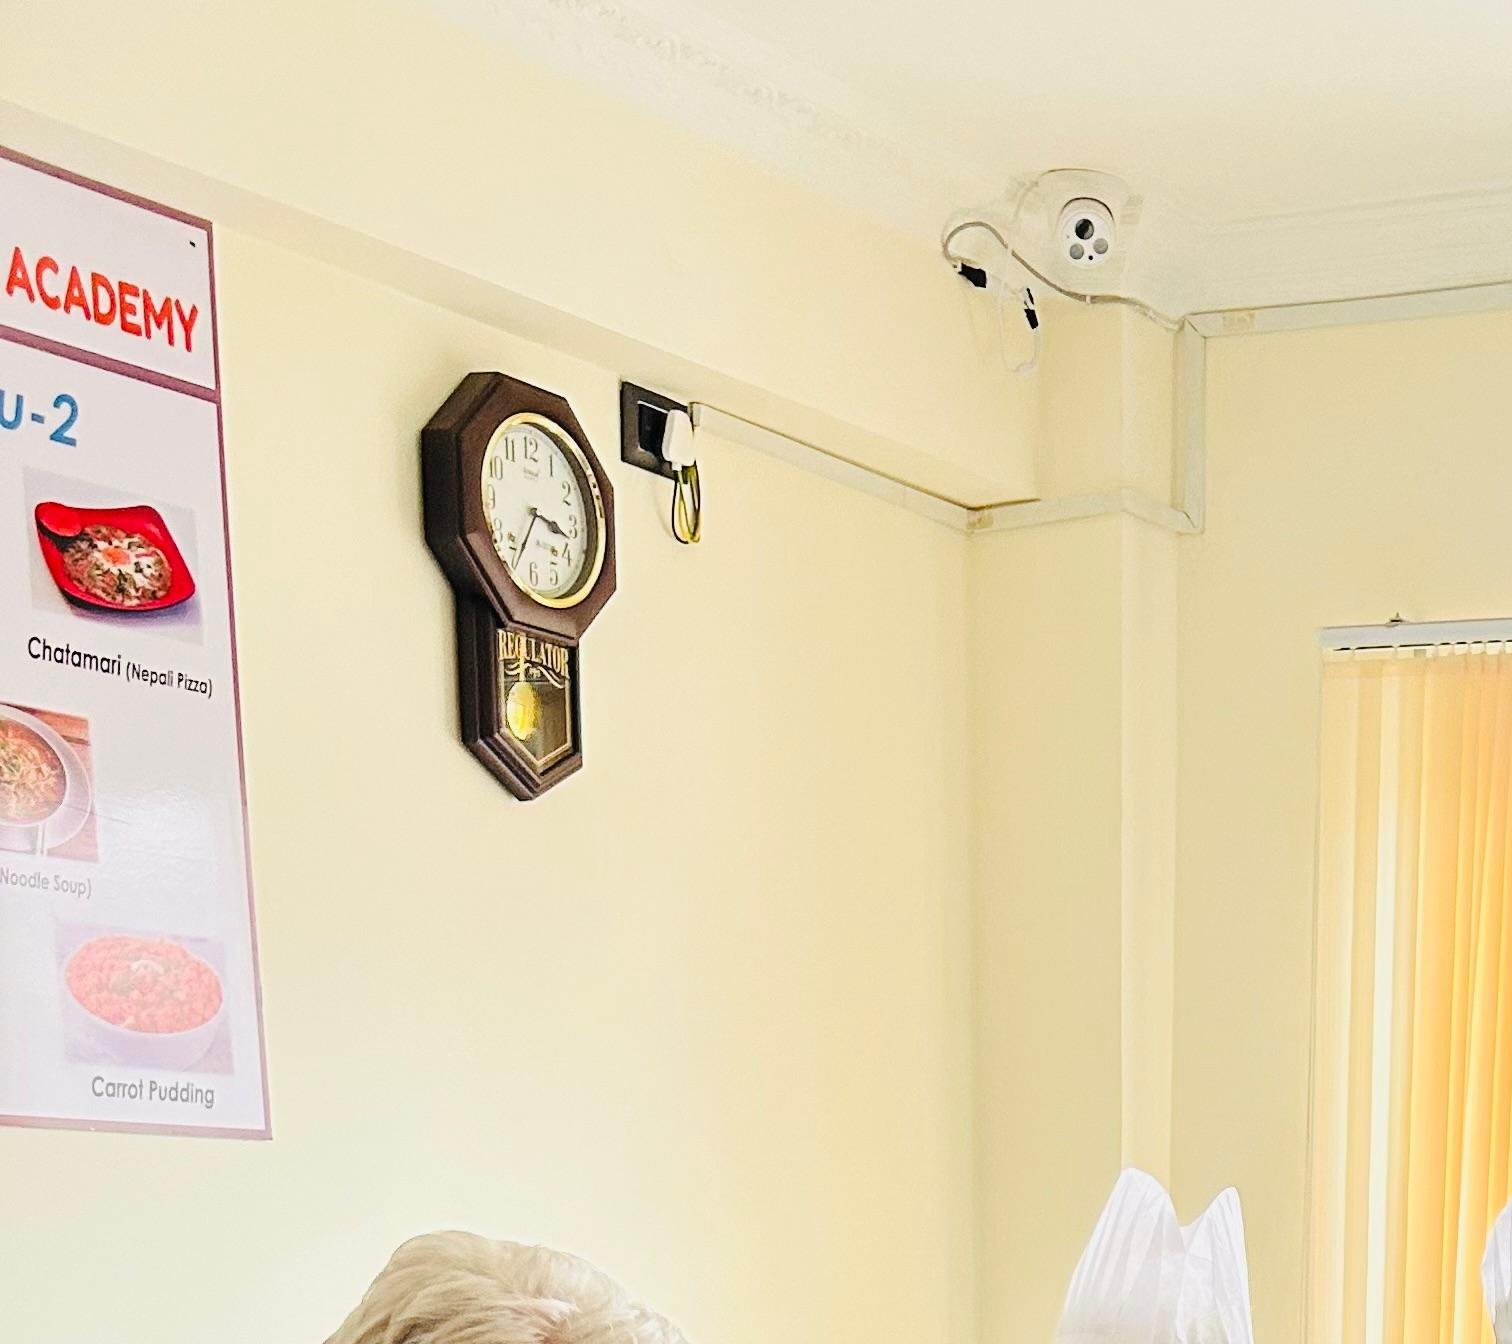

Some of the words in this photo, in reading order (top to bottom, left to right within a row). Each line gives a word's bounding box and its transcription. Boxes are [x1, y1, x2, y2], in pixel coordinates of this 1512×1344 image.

[6, 246, 198, 352] ACADEMY
[27, 636, 122, 676] Chatamari
[126, 661, 174, 688] (Nepali
[177, 672, 213, 699] Pizza)
[53, 874, 92, 899] Soup)
[92, 1076, 143, 1100] Carrot
[149, 1080, 215, 1109] Pudding
